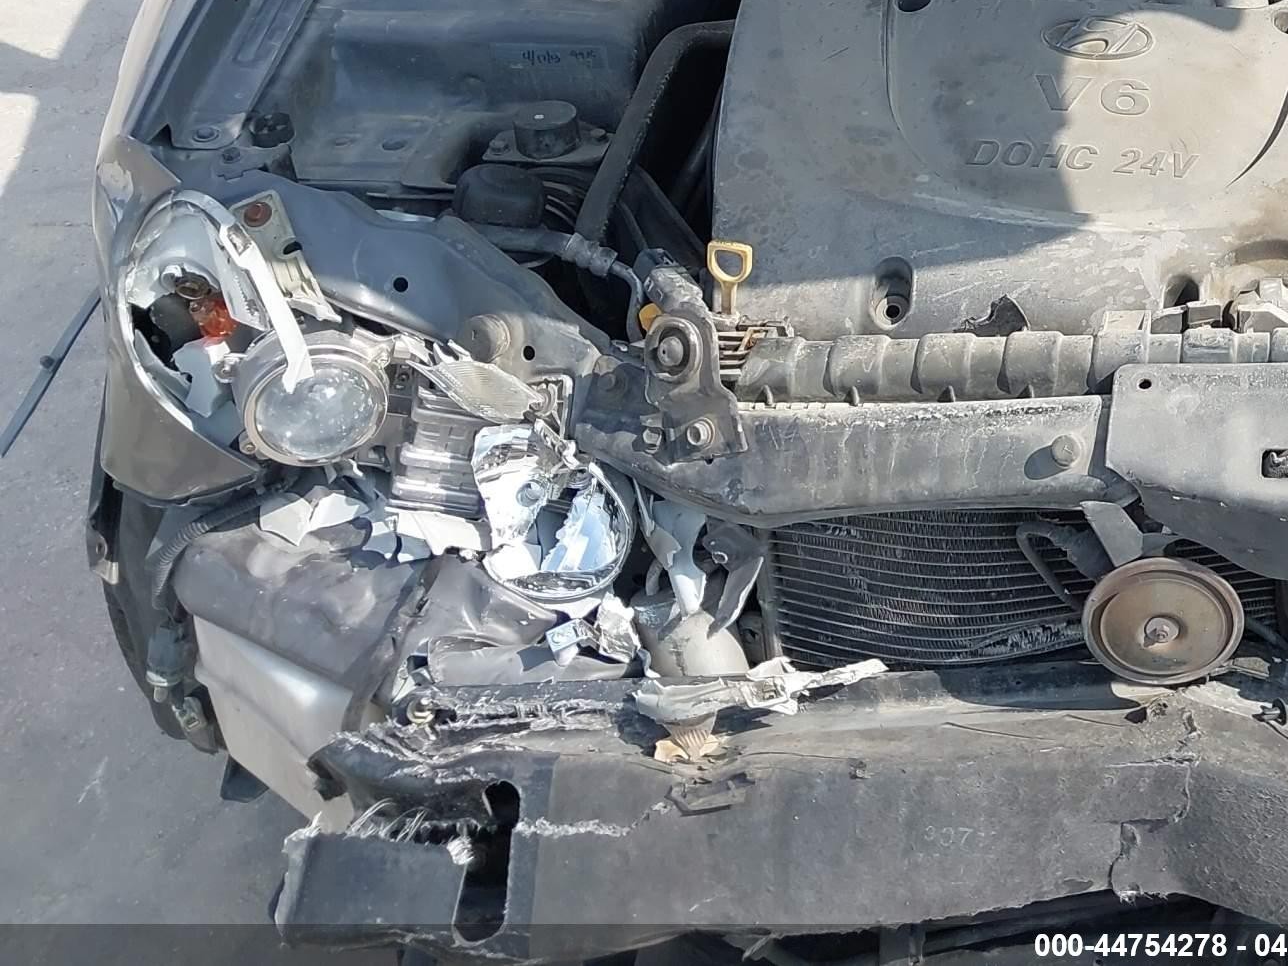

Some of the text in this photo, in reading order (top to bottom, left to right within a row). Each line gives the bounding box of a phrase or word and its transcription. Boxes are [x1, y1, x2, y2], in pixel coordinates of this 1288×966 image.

[1033, 73, 1151, 116] V6
[965, 139, 1200, 179] DOHC 24V
